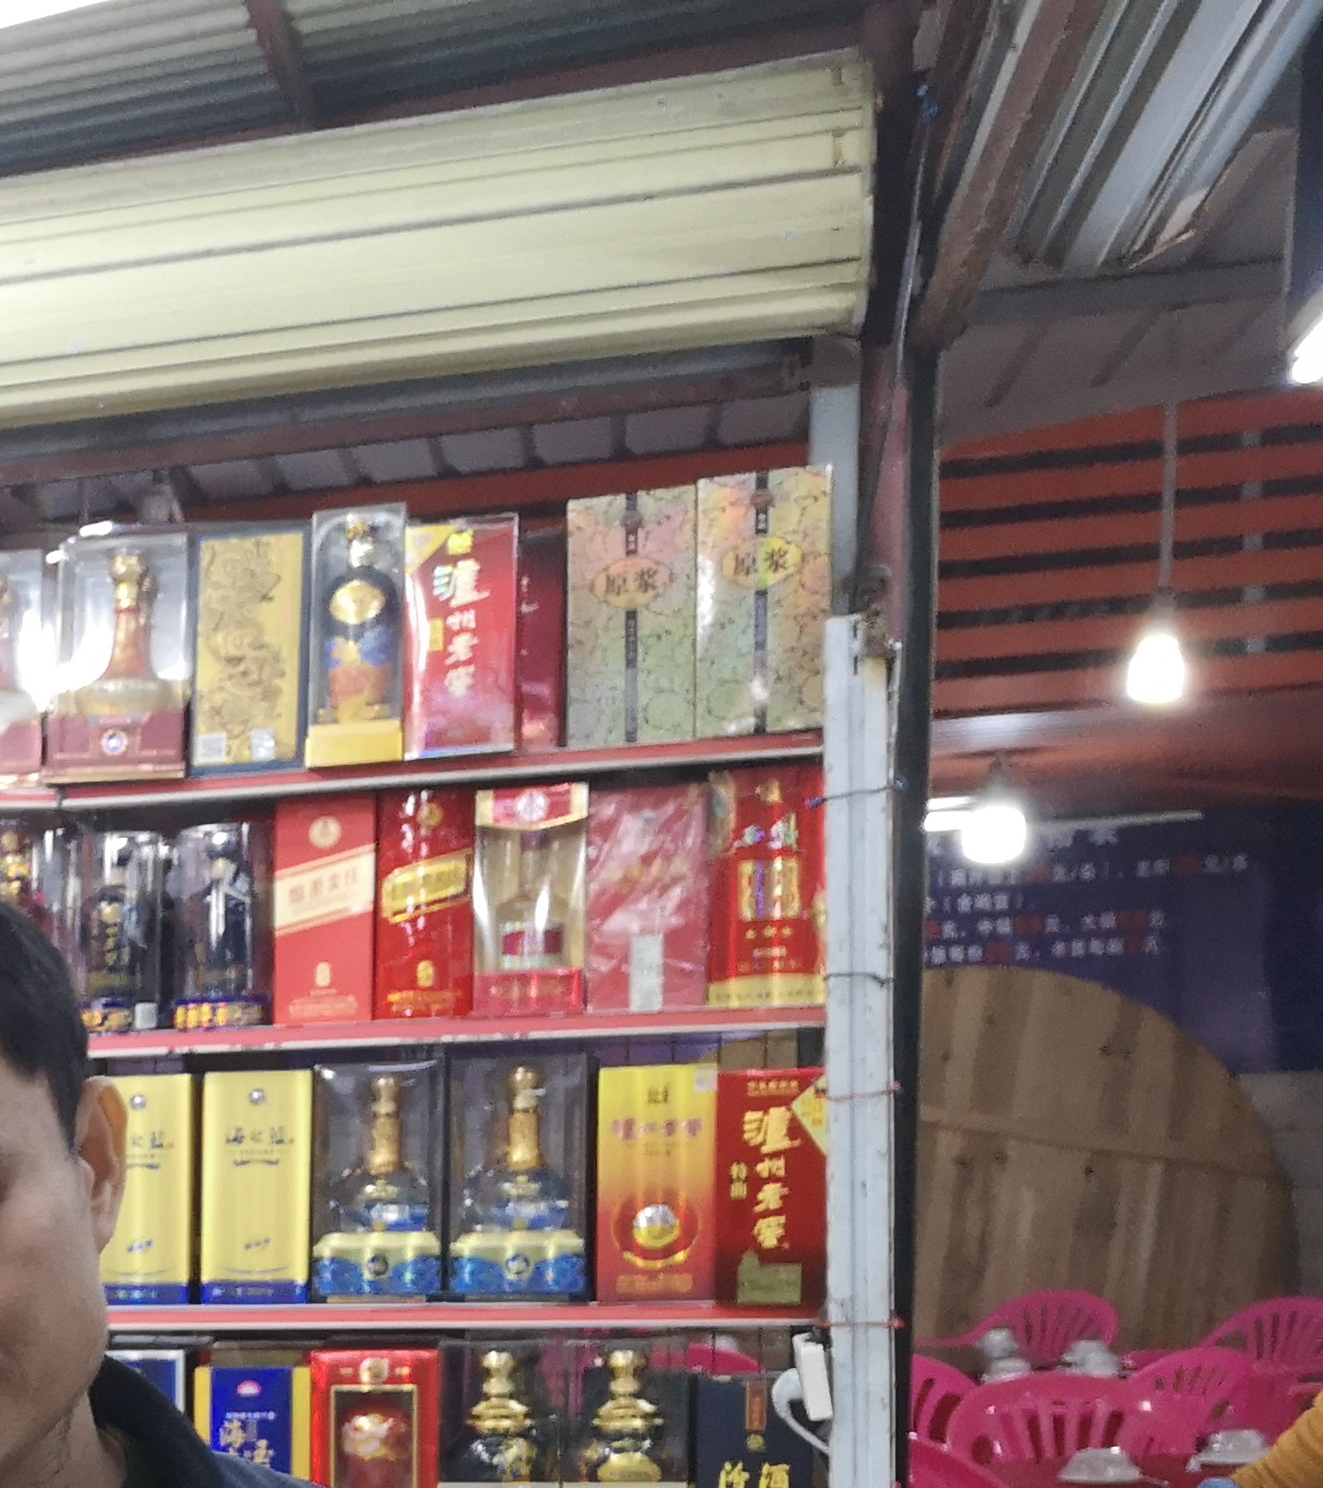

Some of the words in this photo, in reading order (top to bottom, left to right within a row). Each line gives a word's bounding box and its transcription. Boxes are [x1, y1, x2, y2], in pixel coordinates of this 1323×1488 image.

[433, 559, 490, 698] 泸州老窖
[743, 1105, 802, 1251] 泸州老窖
